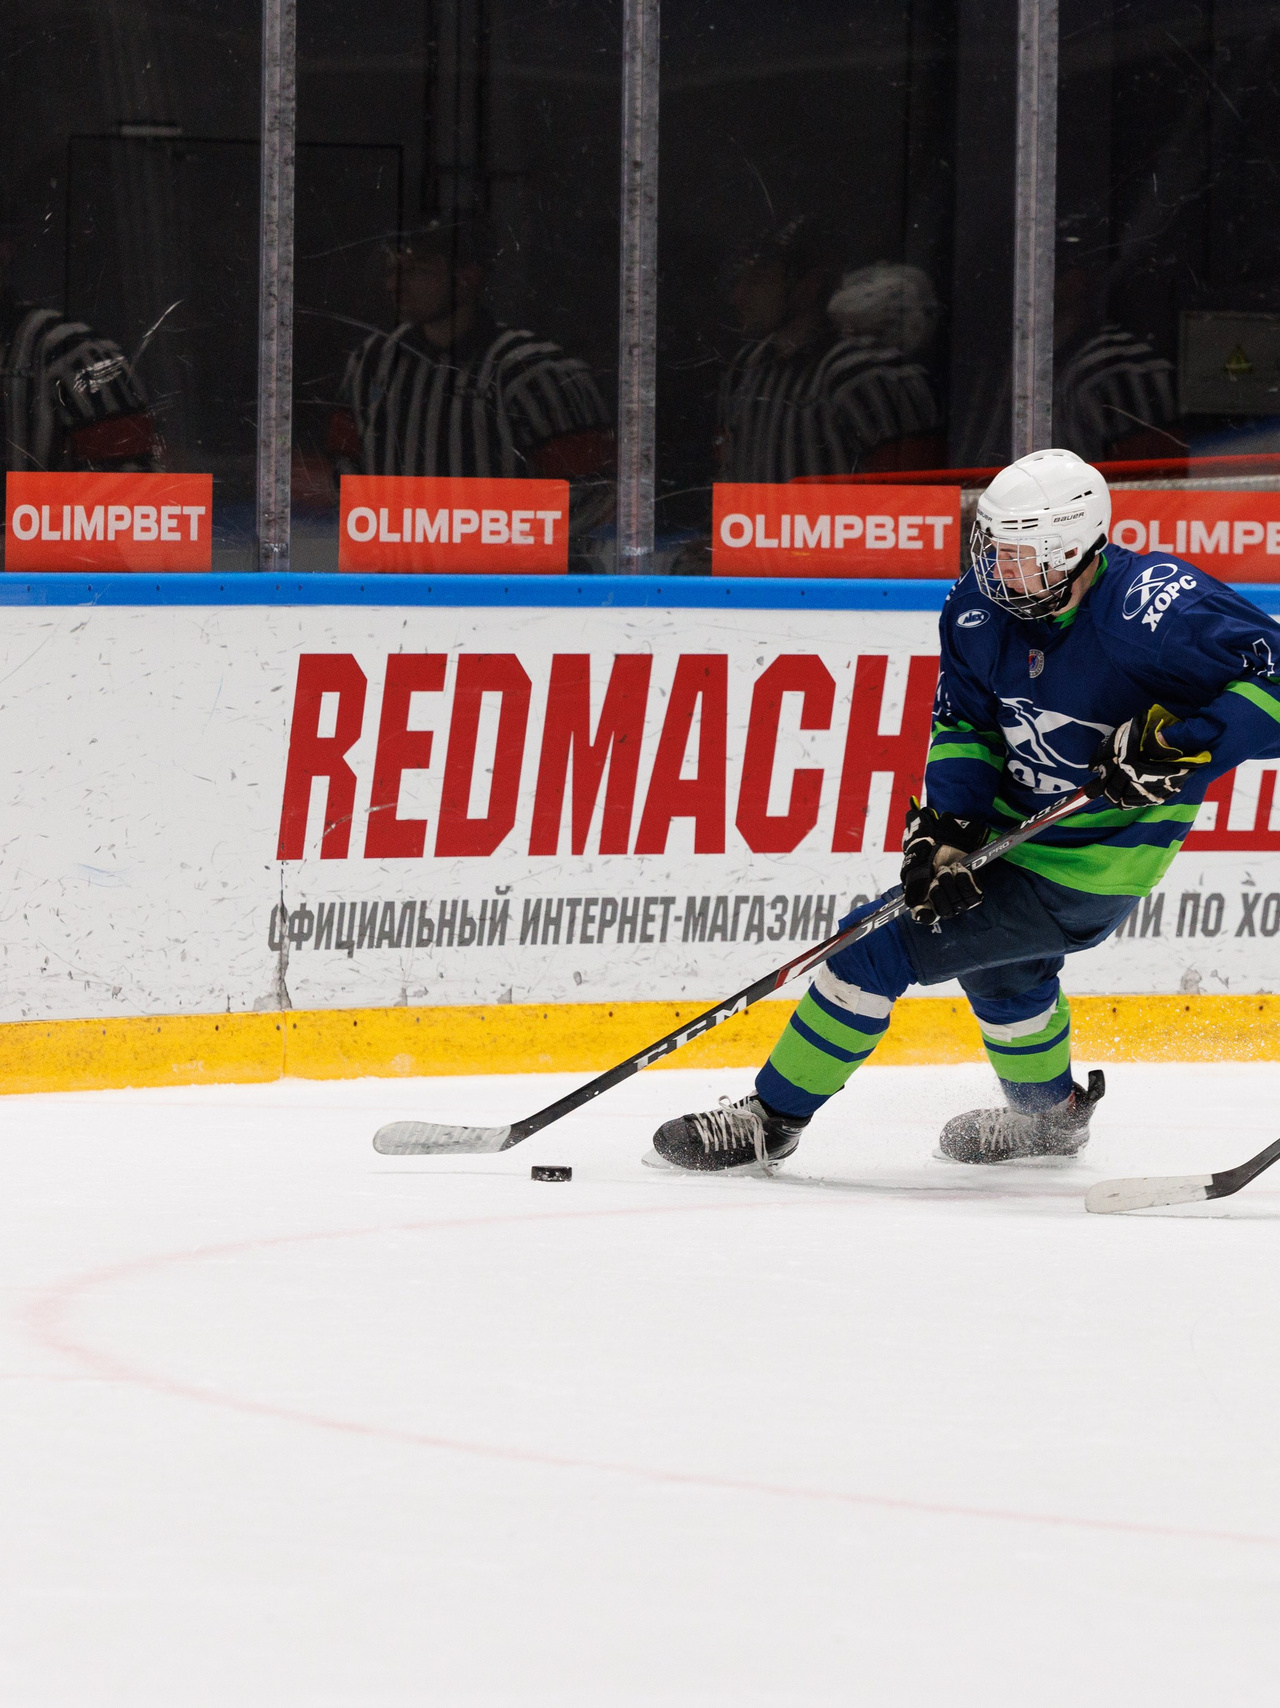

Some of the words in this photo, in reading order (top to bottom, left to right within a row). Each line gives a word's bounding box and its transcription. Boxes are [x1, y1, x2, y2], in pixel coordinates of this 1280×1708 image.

[12, 503, 206, 542] OLIMPBET
[346, 506, 562, 545] OLIMPBET
[719, 513, 954, 550] OLIMPBET
[1141, 575, 1197, 632] ХОРС
[267, 886, 511, 958] ОФИЦИАЛЬНЫЙ
[519, 895, 837, 946] ИНТЕРНЕТ-МАГАЗИН
[1175, 893, 1225, 937] ПО
